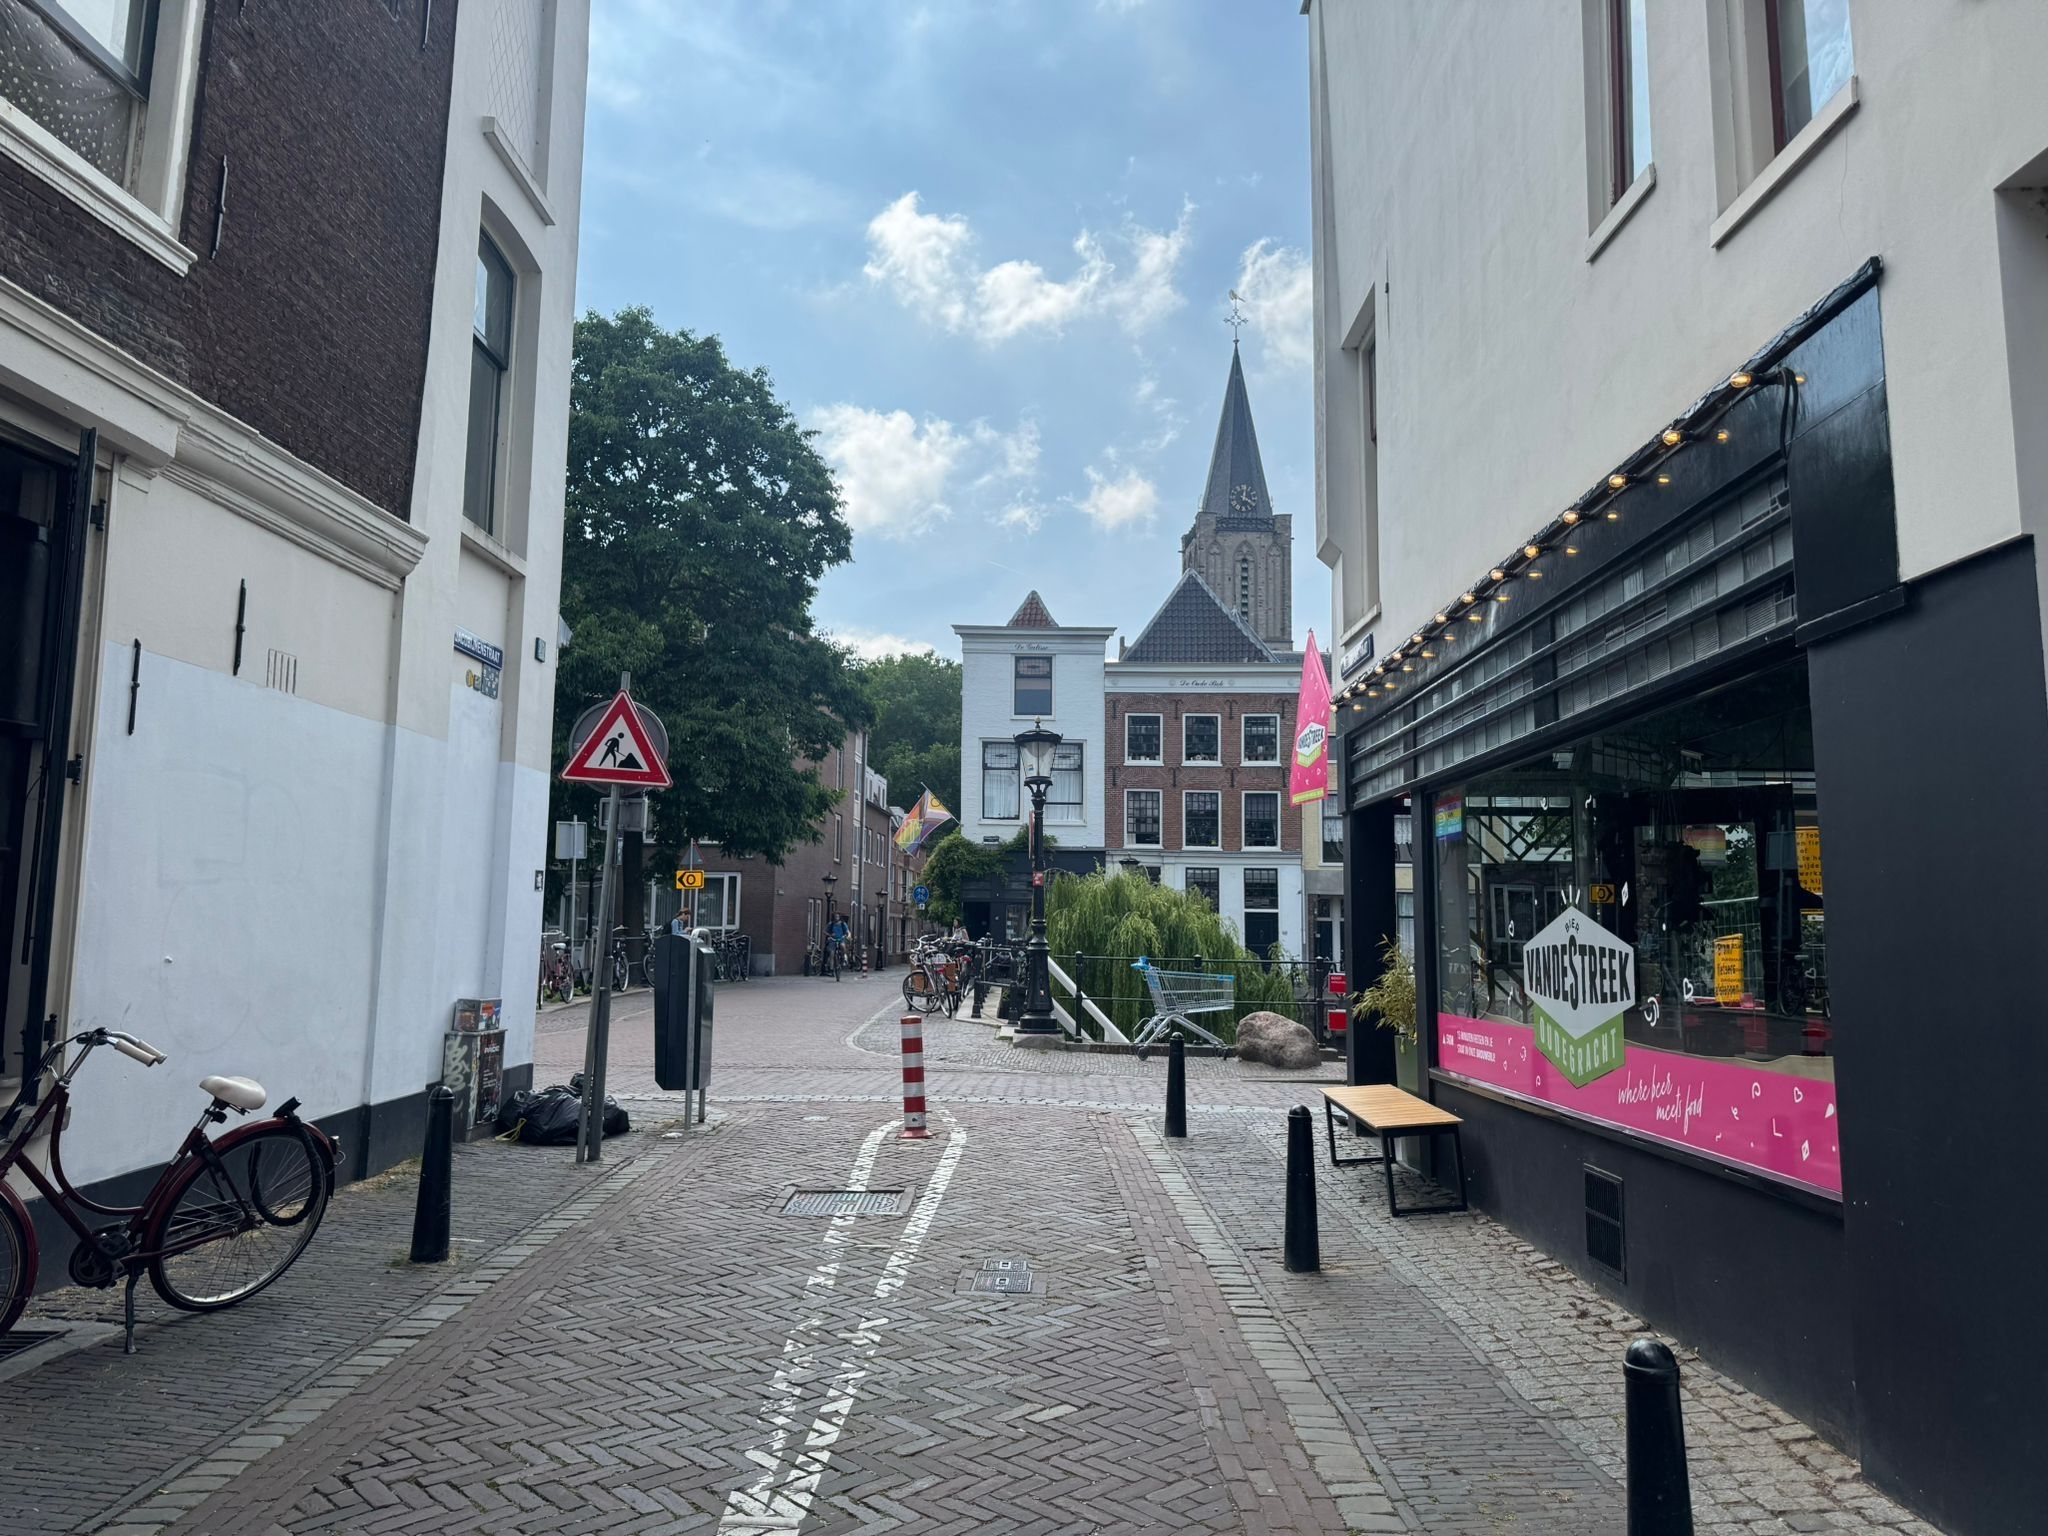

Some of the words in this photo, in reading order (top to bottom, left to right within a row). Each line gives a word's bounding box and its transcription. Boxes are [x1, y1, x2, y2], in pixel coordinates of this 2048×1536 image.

[1564, 918, 1580, 935] BIER
[1526, 934, 1631, 1011] VANDESTREEK
[1539, 1015, 1617, 1077] OUDEGRACHT
[1618, 1069, 1650, 1104] where
[1650, 1064, 1673, 1103] beer
[1656, 1085, 1682, 1123] meets
[1683, 1081, 1704, 1136] food
